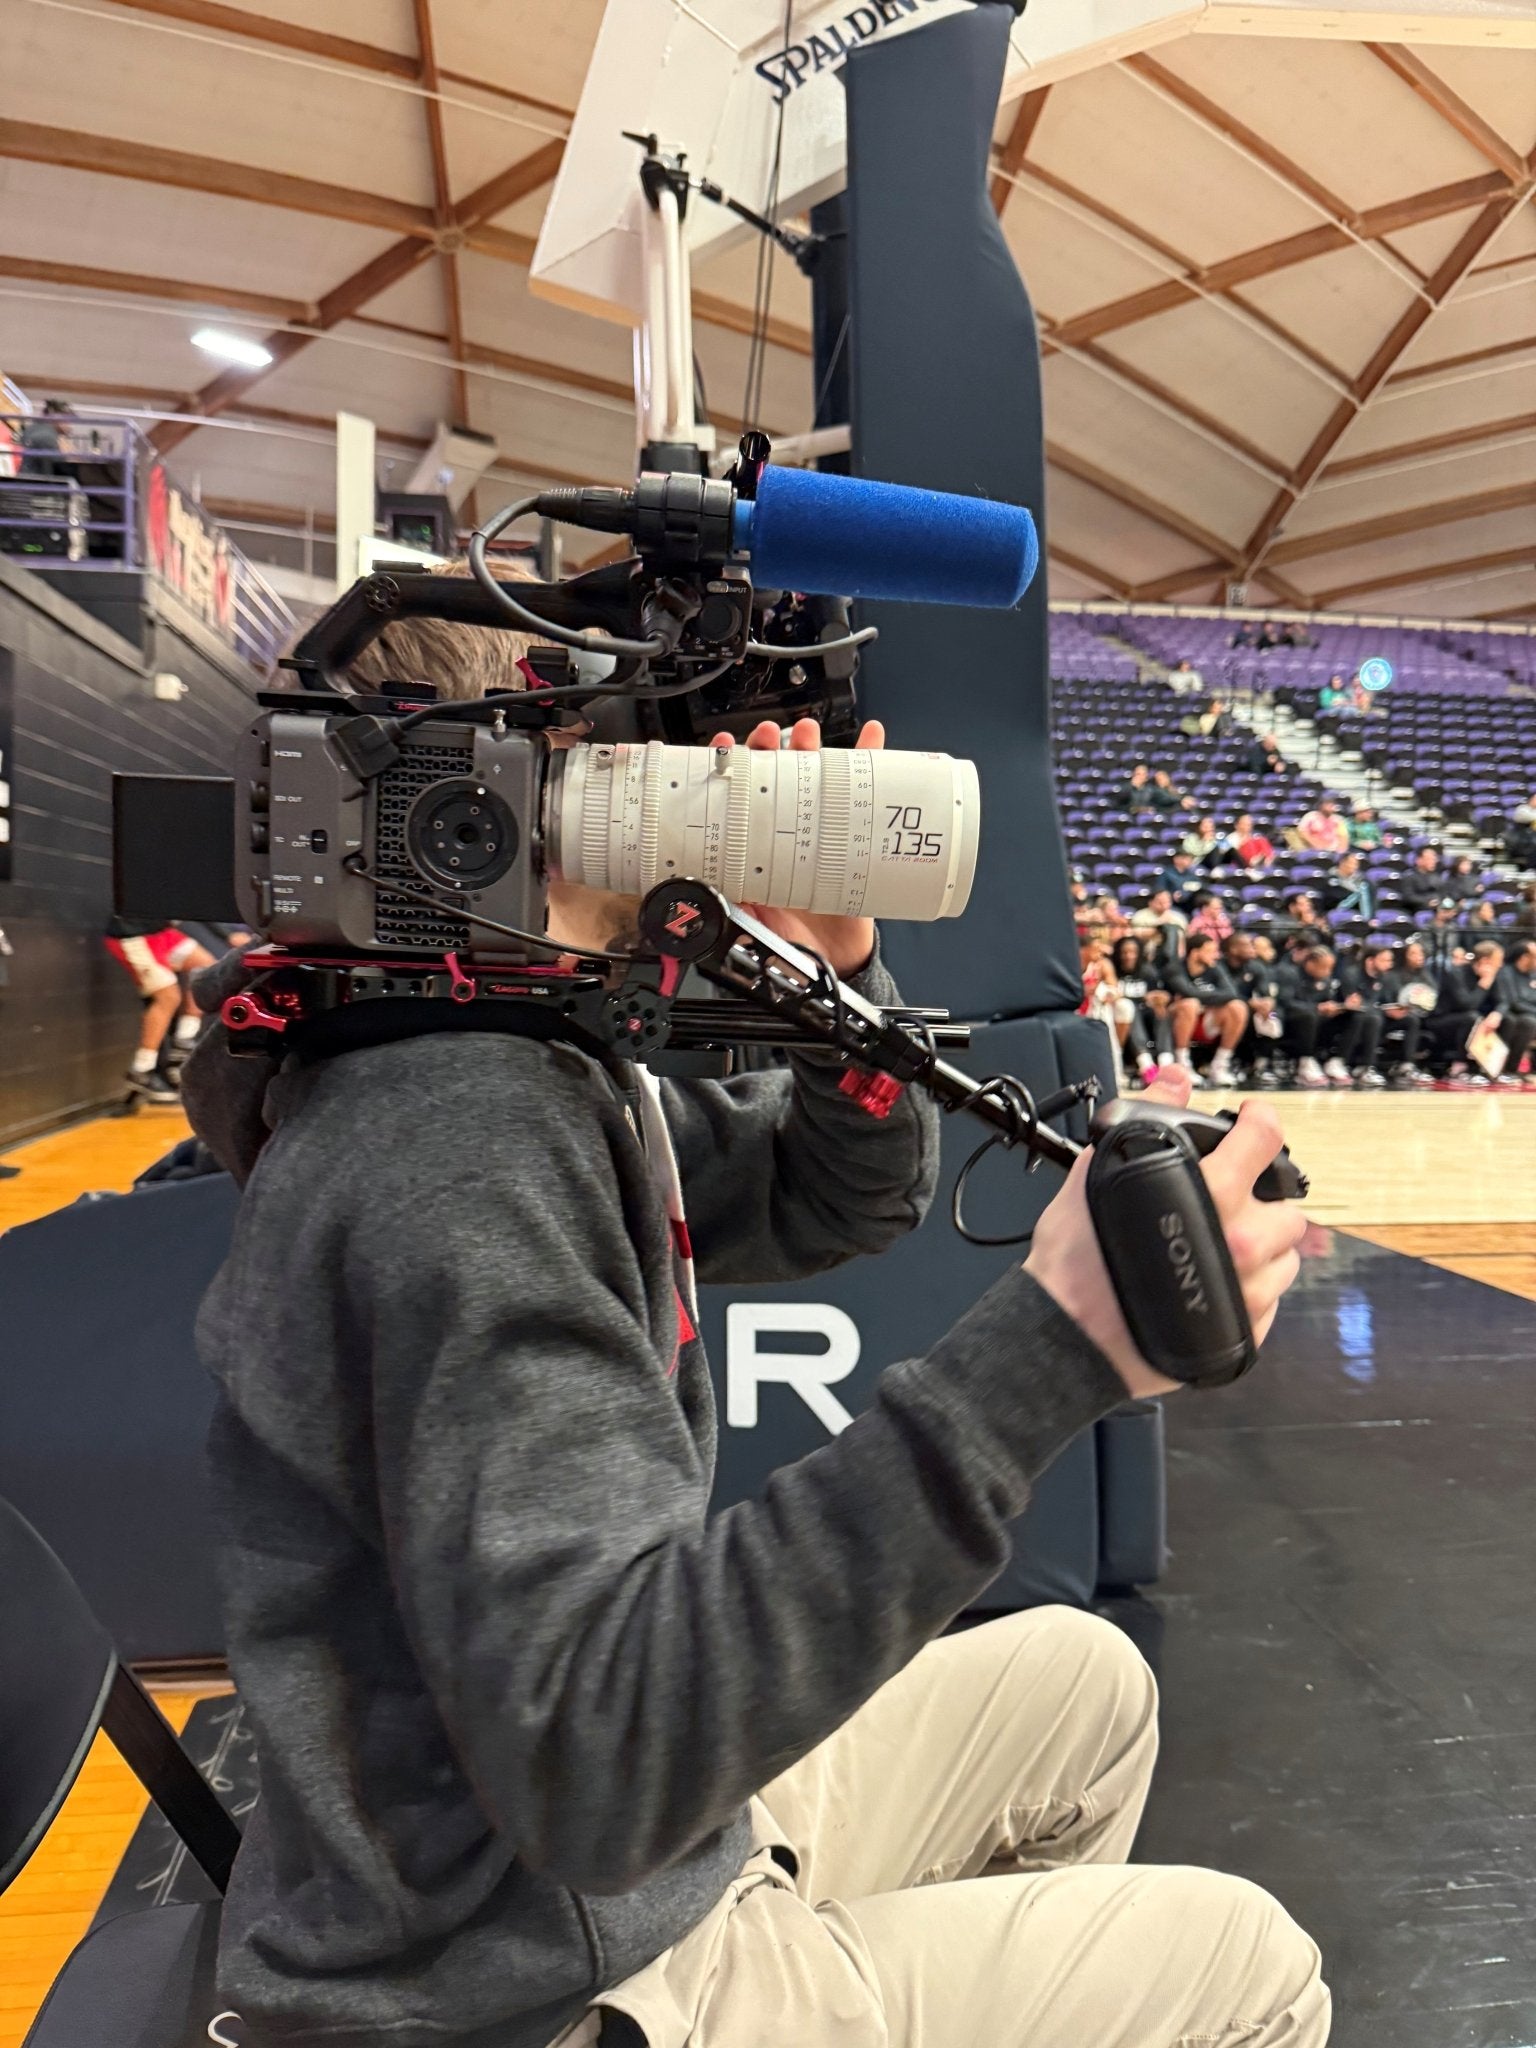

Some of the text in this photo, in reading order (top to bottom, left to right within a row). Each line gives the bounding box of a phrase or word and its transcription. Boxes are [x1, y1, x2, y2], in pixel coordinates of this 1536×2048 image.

[886, 805, 922, 830] 70
[891, 831, 943, 857] 135
[1160, 1211, 1209, 1313] SONY
[726, 1302, 861, 1437] R
